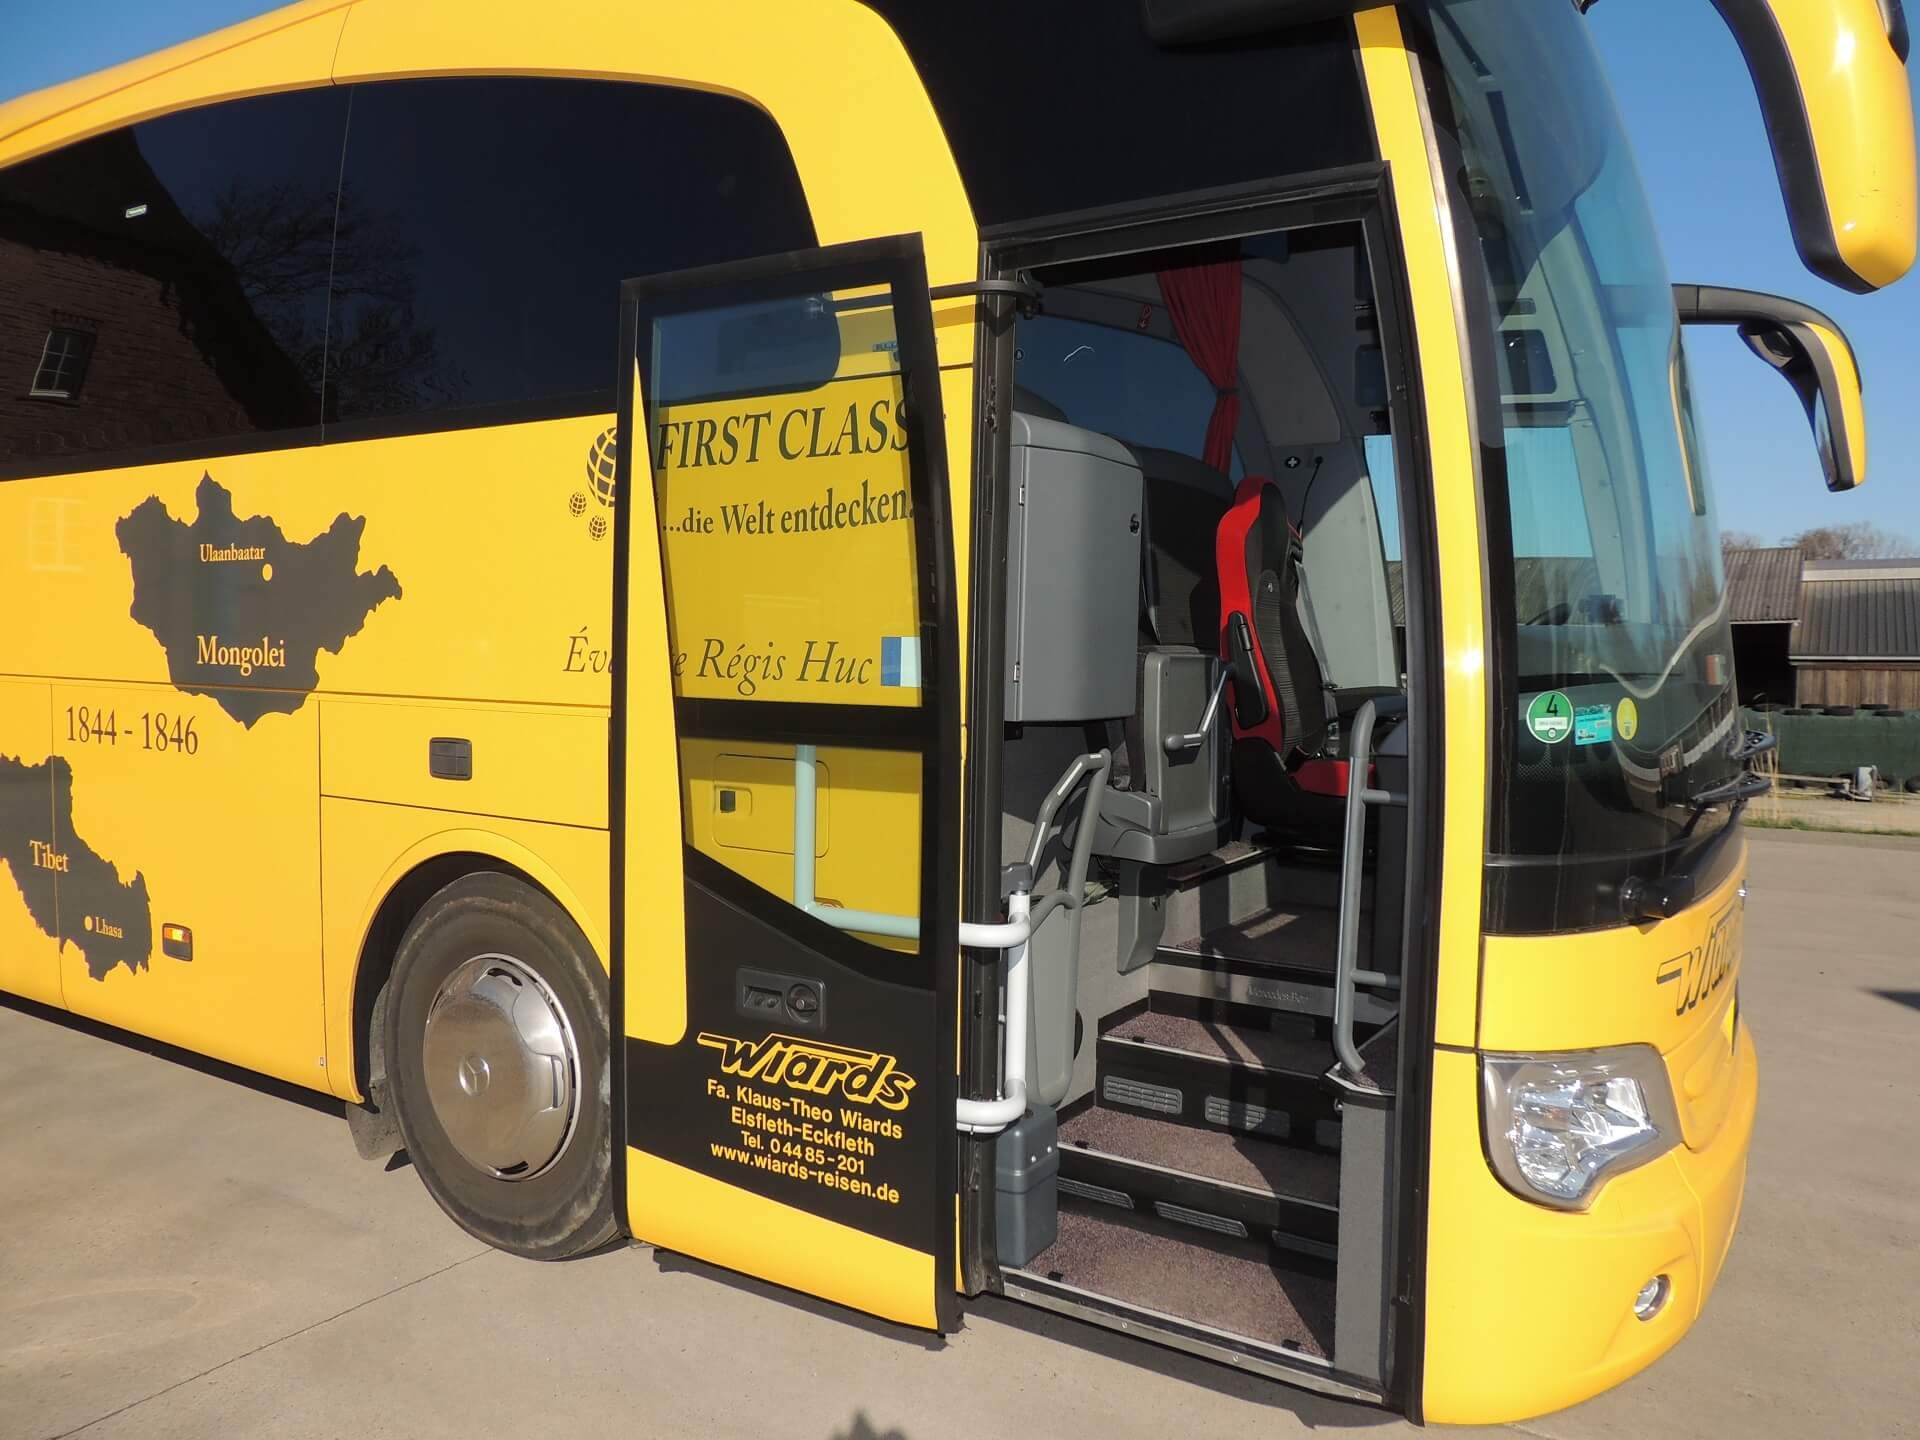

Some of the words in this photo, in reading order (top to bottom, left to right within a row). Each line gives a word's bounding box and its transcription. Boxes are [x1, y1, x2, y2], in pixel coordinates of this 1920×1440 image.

[656, 410, 772, 470] FIRST
[778, 398, 909, 461] CLASS
[720, 500, 775, 535] Welt
[200, 543, 265, 562] Ulaanbaatar
[197, 635, 286, 677] Mongolei
[696, 638, 787, 696] Régis
[796, 640, 873, 684] Huc
[1546, 694, 1559, 717] 4
[66, 705, 117, 745] 1844
[141, 712, 198, 755] 1846
[29, 839, 69, 872] Tibet
[95, 916, 123, 939] Lhasa
[707, 1079, 730, 1099] Fa.
[737, 1085, 833, 1123] Klaus-Theo
[840, 1108, 903, 1139] Wiards
[731, 1106, 875, 1156] Elsfleth-Eckfleth
[741, 1130, 764, 1150] Tel.
[711, 1143, 900, 1203] www.wiards-reisen.de
